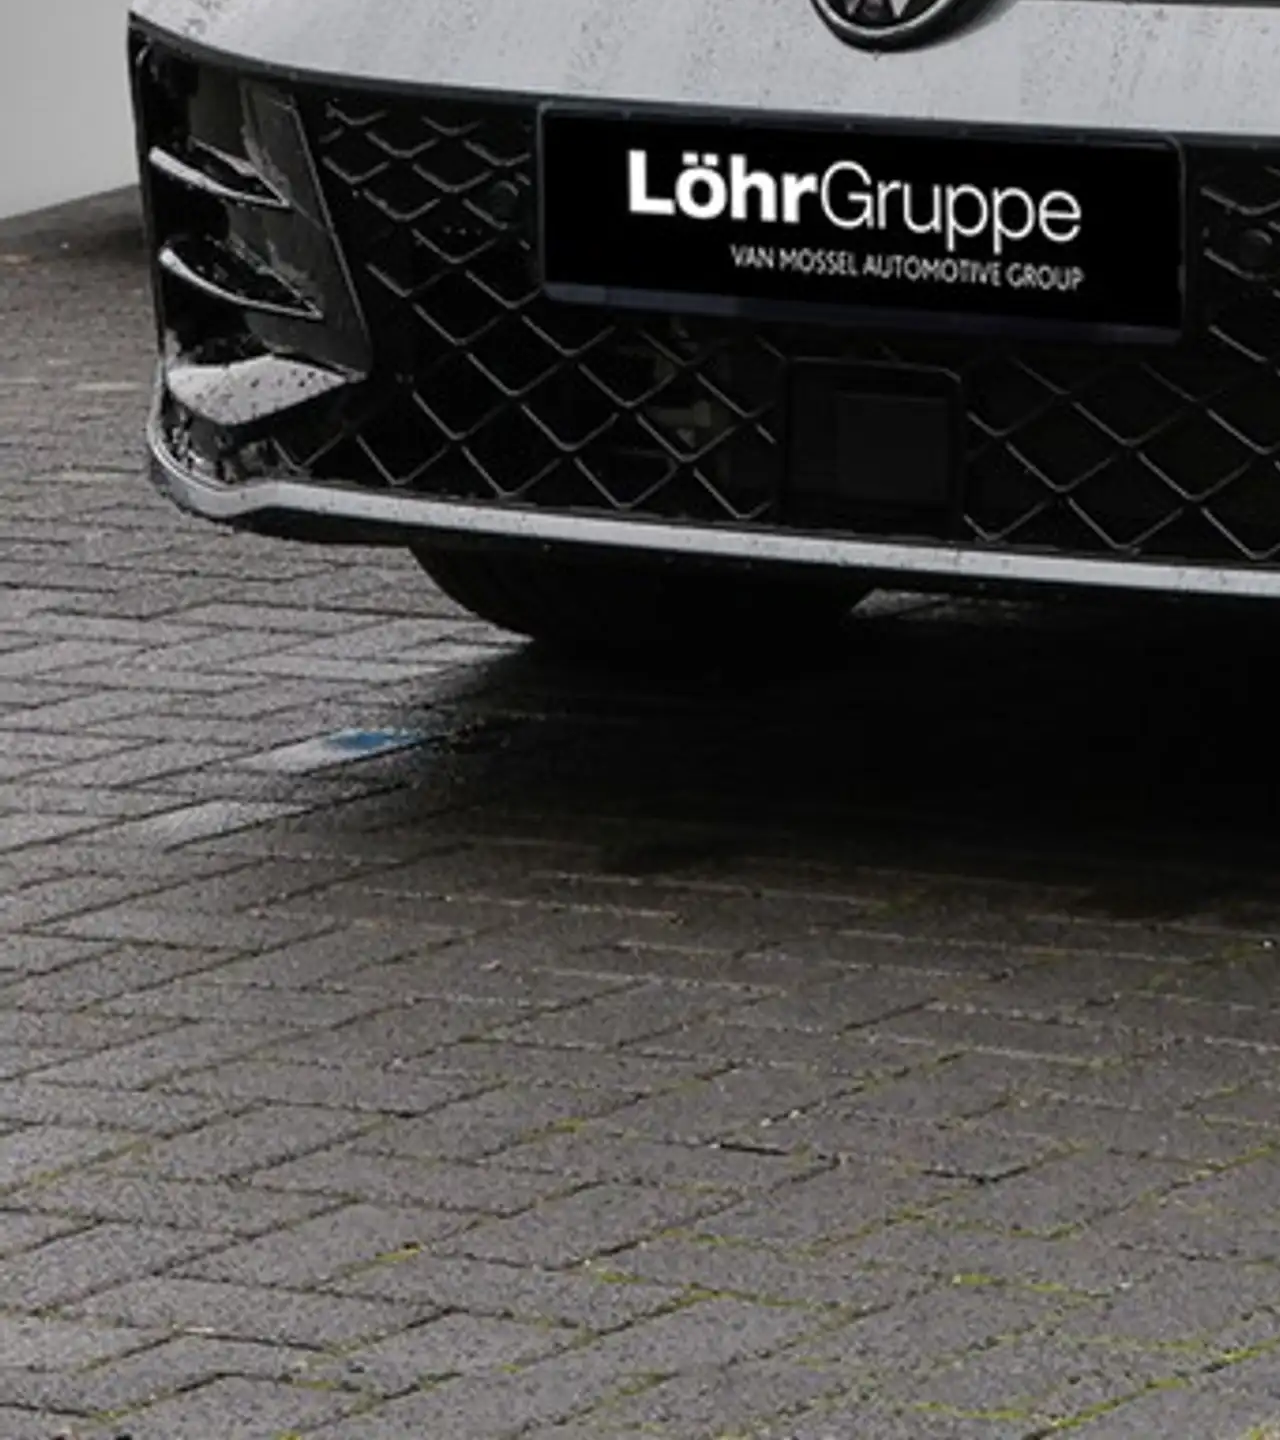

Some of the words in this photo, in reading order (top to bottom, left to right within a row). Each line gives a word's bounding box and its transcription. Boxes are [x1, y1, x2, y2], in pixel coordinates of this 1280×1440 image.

[628, 149, 1083, 254] LöhrGruppe
[730, 243, 774, 269] VAN
[778, 247, 858, 277] MOSSEL
[863, 253, 1001, 287] AUTOMOTIVE
[1004, 261, 1085, 291] GROUP
